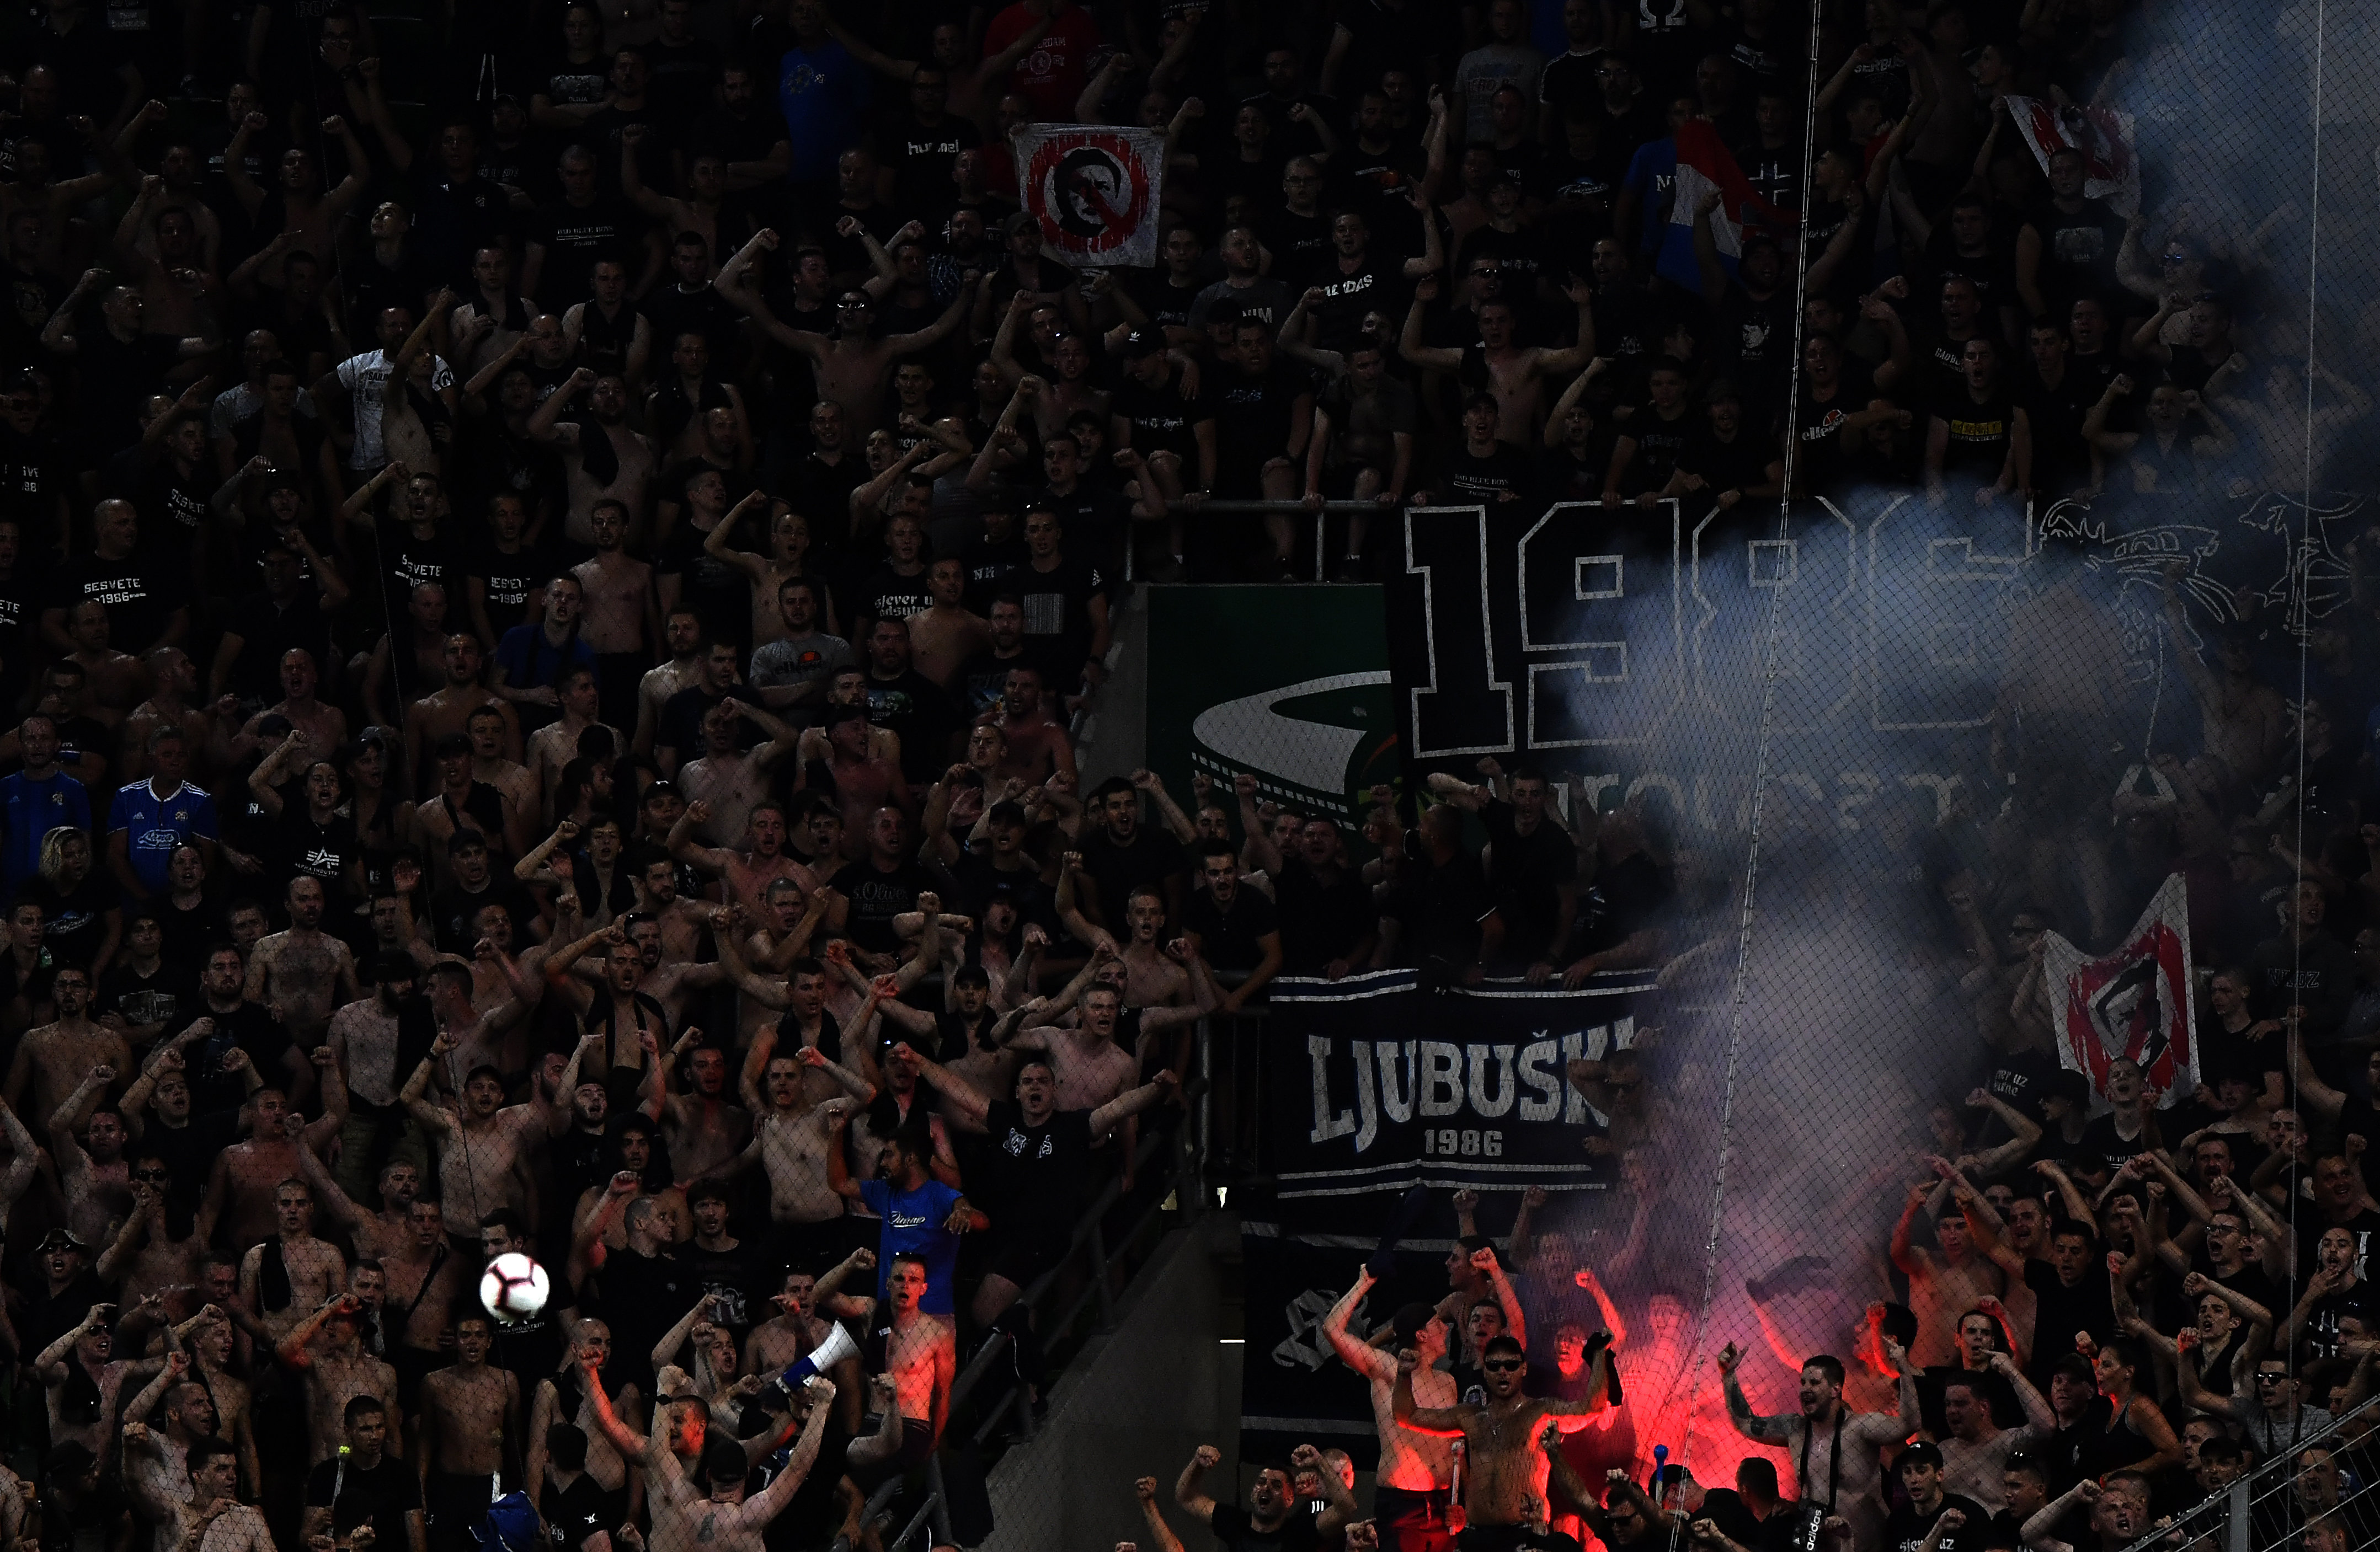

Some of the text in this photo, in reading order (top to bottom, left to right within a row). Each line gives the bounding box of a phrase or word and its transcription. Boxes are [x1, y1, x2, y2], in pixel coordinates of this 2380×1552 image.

[402, 553, 442, 577] SSVETE
[84, 577, 141, 594] SESVETE
[100, 592, 130, 605] 1986
[313, 868, 340, 877] INDUSTR
[1424, 1128, 1503, 1157] 1986
[1807, 1508, 1822, 1551] adidas
